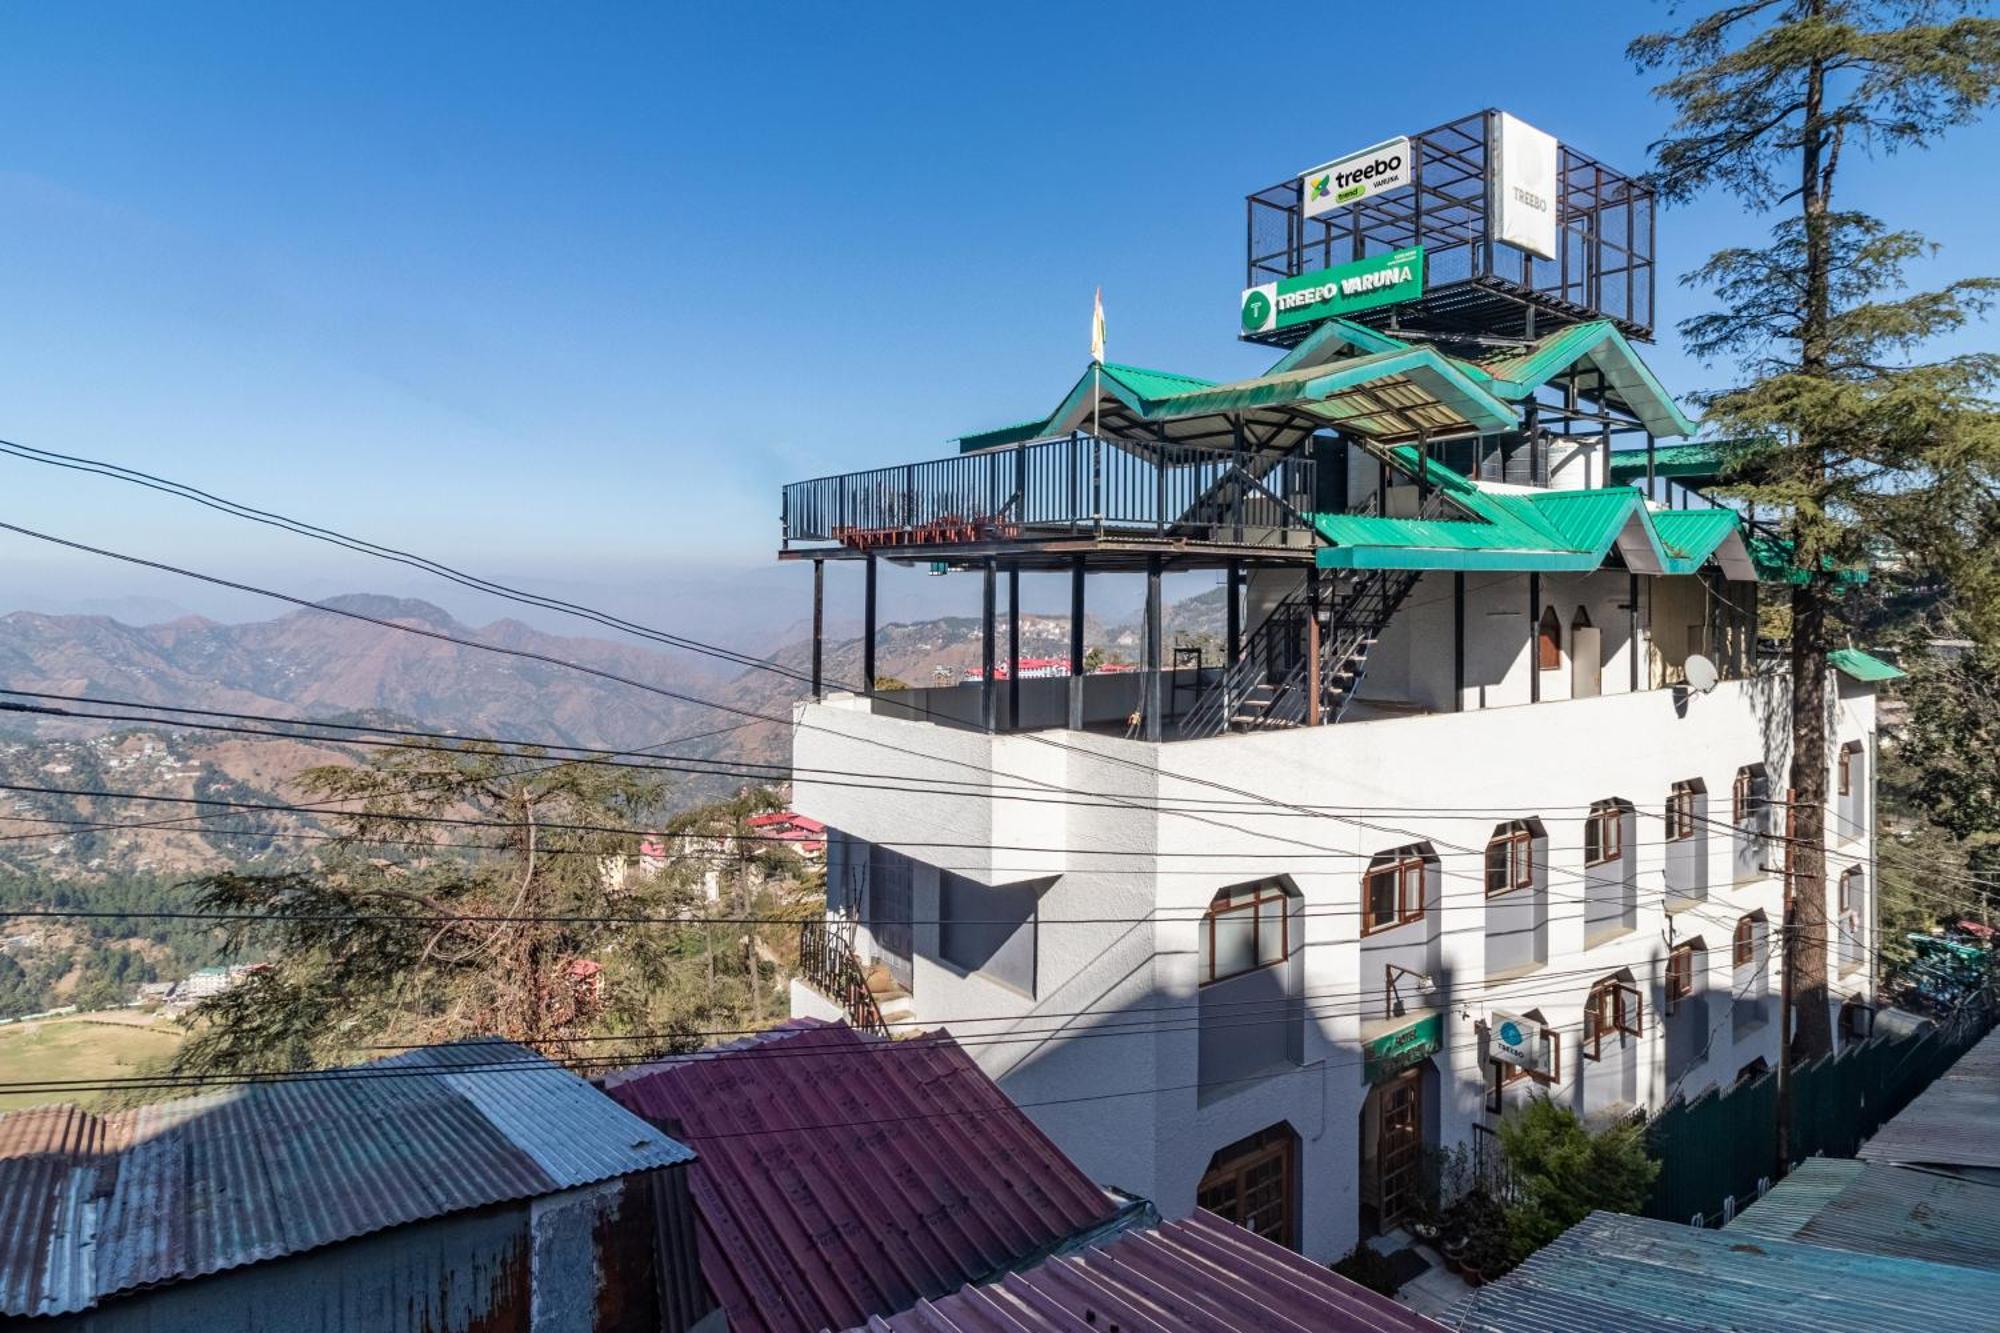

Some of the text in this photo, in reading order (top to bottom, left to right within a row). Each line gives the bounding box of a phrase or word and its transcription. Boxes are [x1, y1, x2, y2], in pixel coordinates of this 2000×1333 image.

[1335, 155, 1402, 188] treebo
[1513, 186, 1547, 212] TREEBO
[1341, 266, 1413, 295] VARUNA
